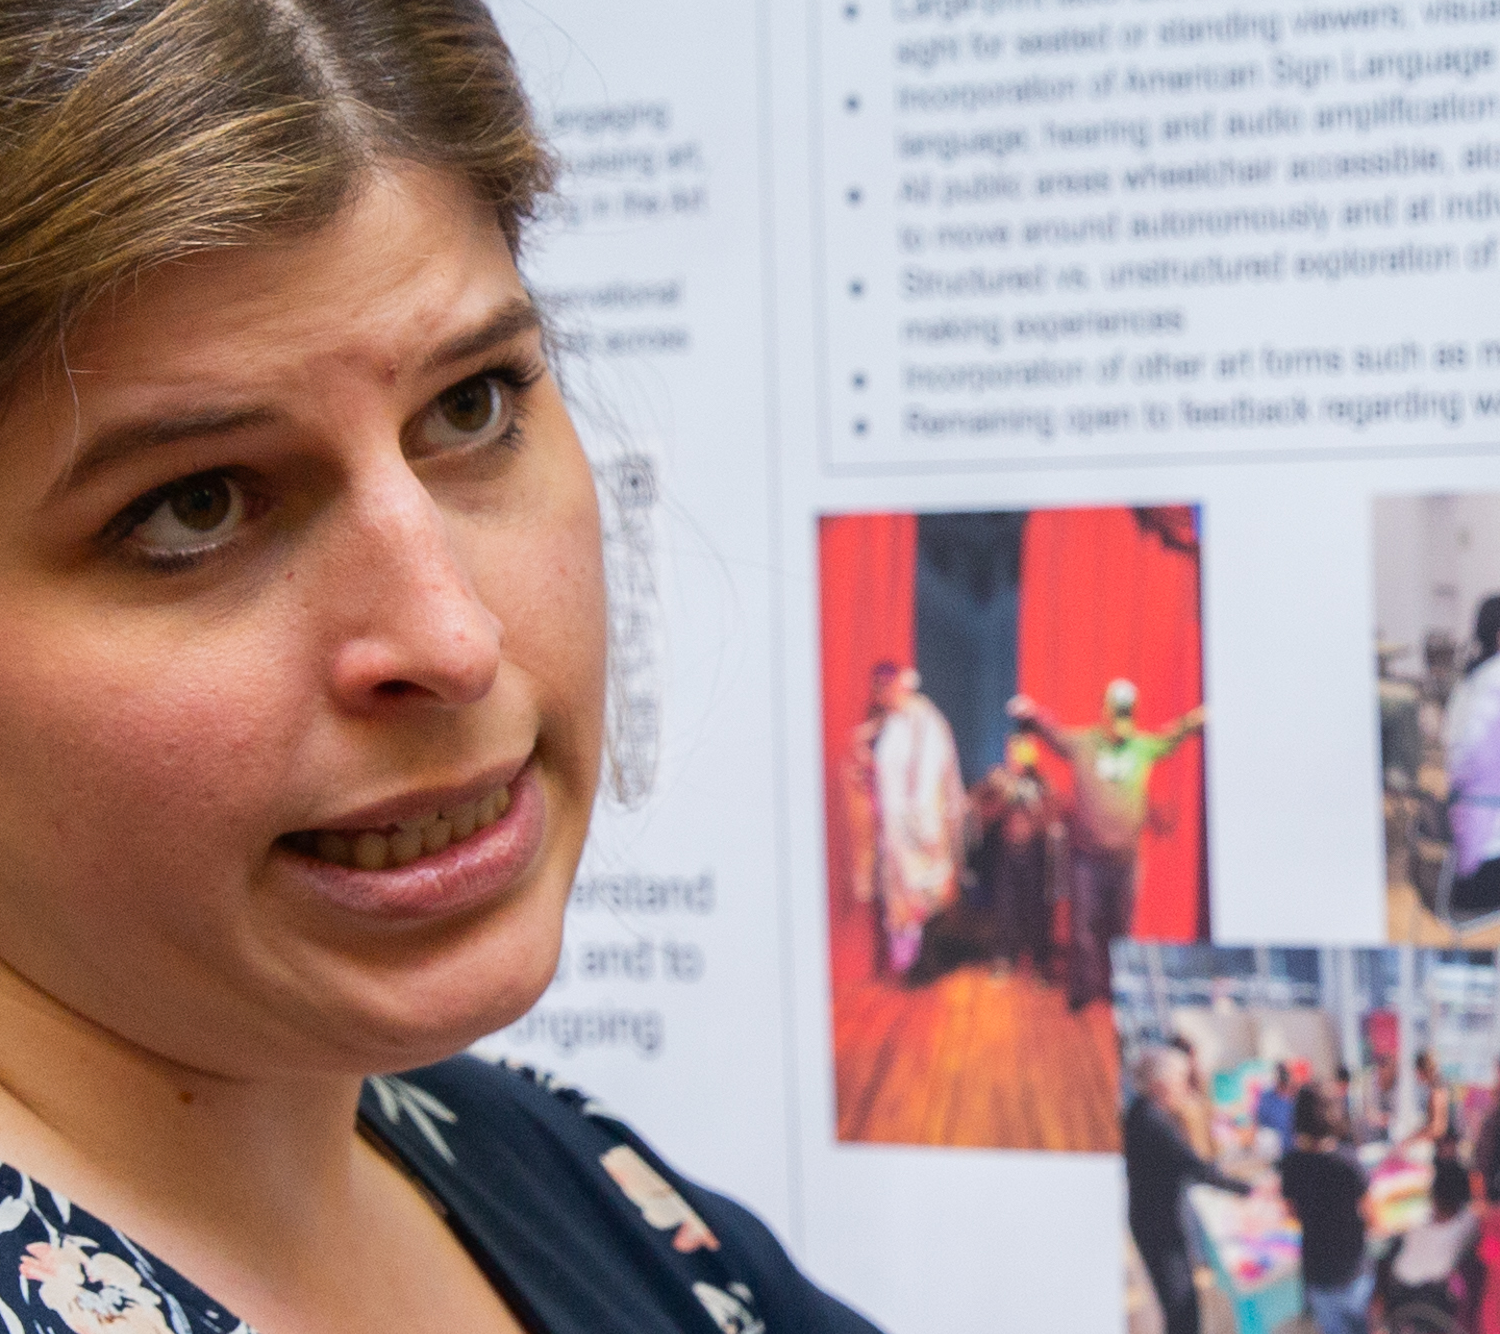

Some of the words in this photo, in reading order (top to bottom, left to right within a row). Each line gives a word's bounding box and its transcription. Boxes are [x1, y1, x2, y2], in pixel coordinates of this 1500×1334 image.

[572, 870, 716, 915] erstand
[578, 940, 653, 982] and
[661, 939, 704, 984] to
